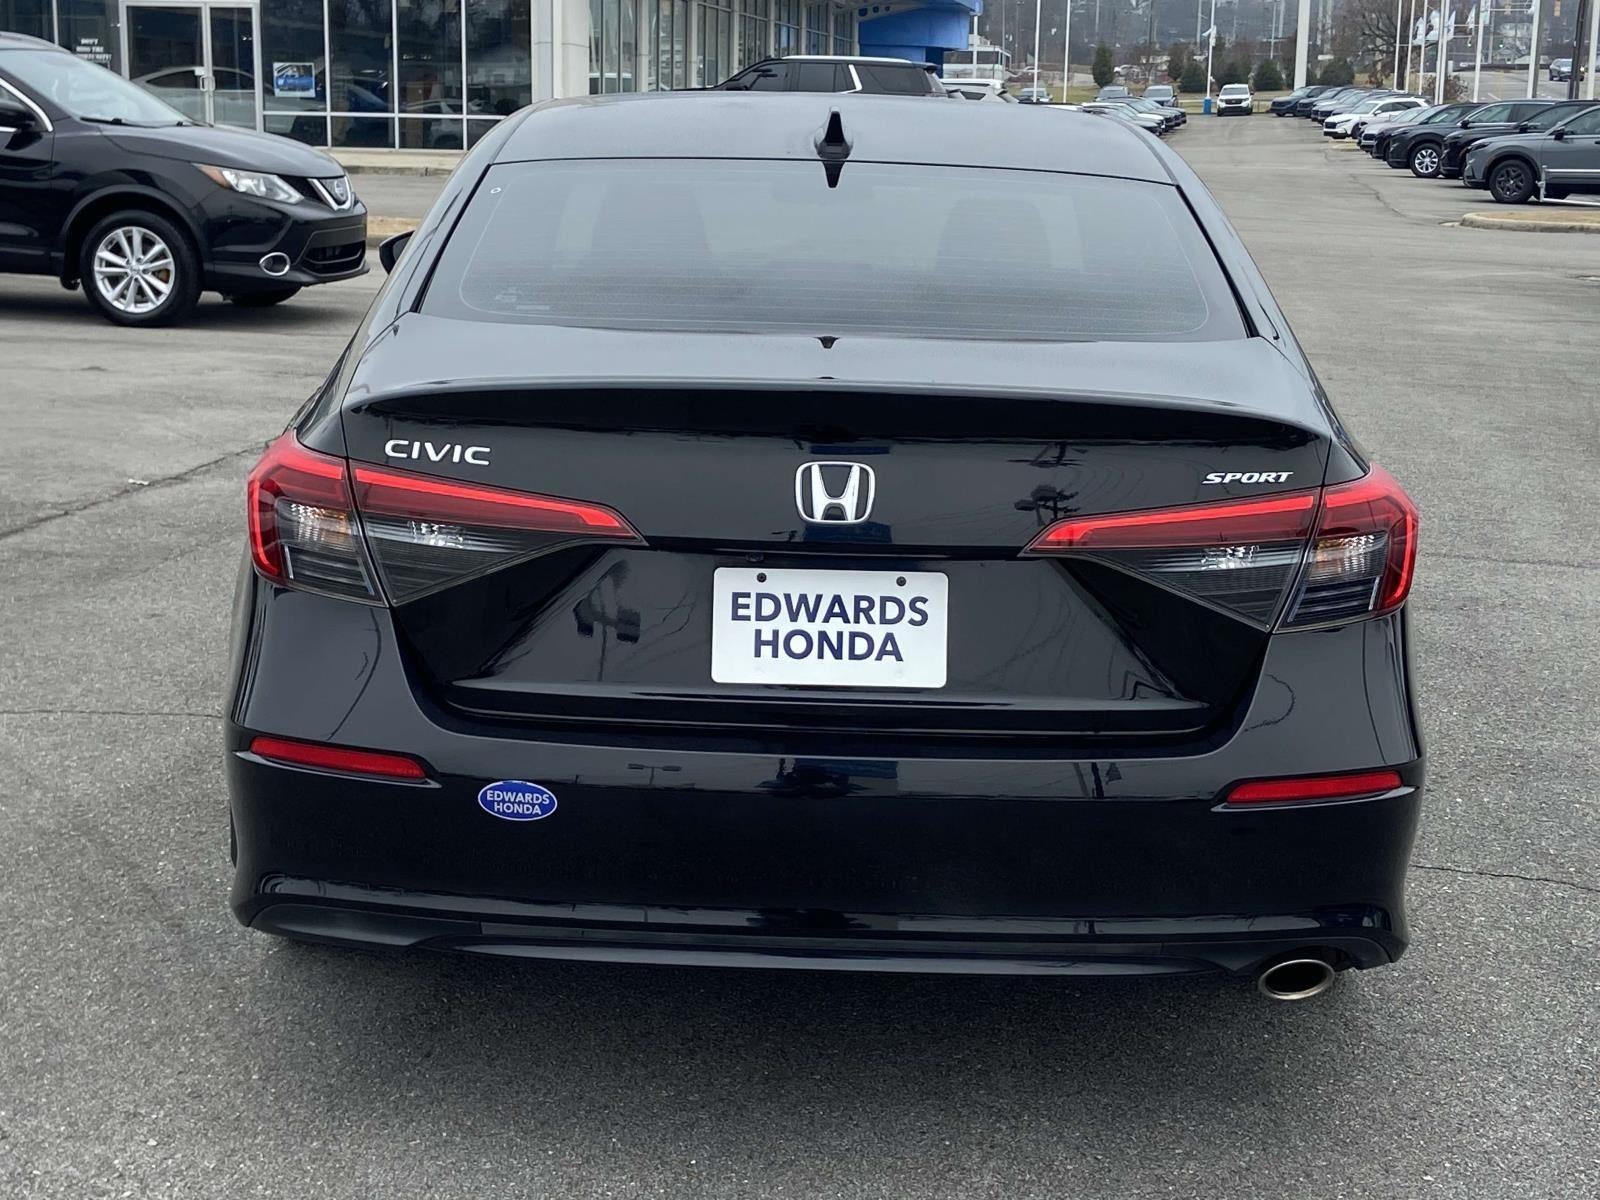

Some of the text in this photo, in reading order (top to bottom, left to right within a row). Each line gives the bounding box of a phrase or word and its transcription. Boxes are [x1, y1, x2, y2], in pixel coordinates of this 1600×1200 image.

[385, 440, 491, 466] CIVIC
[1202, 471, 1294, 484] SPORT
[731, 591, 929, 627] EDWARDS
[753, 628, 904, 662] HONDA
[486, 789, 551, 805] EDWARDS
[493, 801, 542, 815] HONDA
